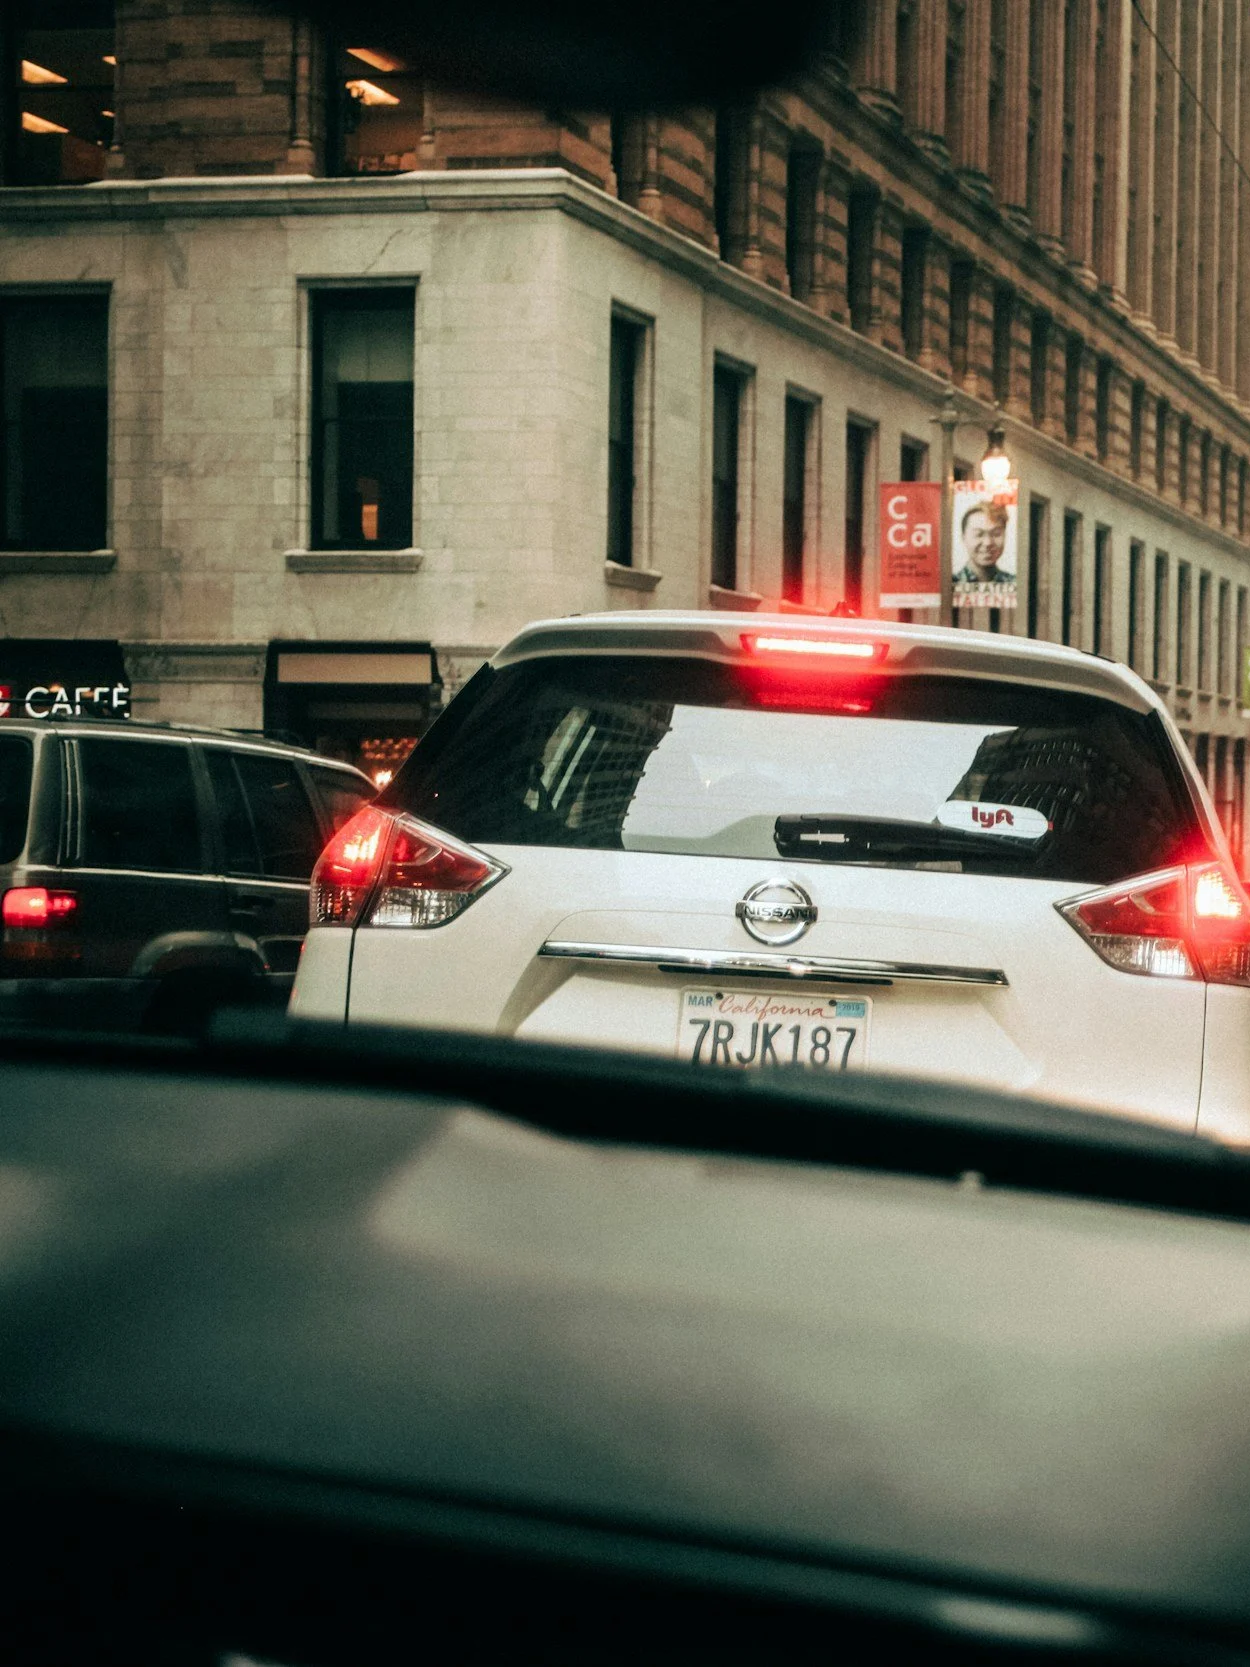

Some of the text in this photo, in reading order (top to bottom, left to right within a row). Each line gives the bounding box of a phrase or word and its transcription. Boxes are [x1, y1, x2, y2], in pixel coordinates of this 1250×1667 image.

[971, 806, 1014, 828] lyft
[743, 905, 811, 919] NISSAN
[688, 994, 714, 1007] MAR
[718, 994, 836, 1021] California
[689, 1018, 857, 1070] 7RJK187
